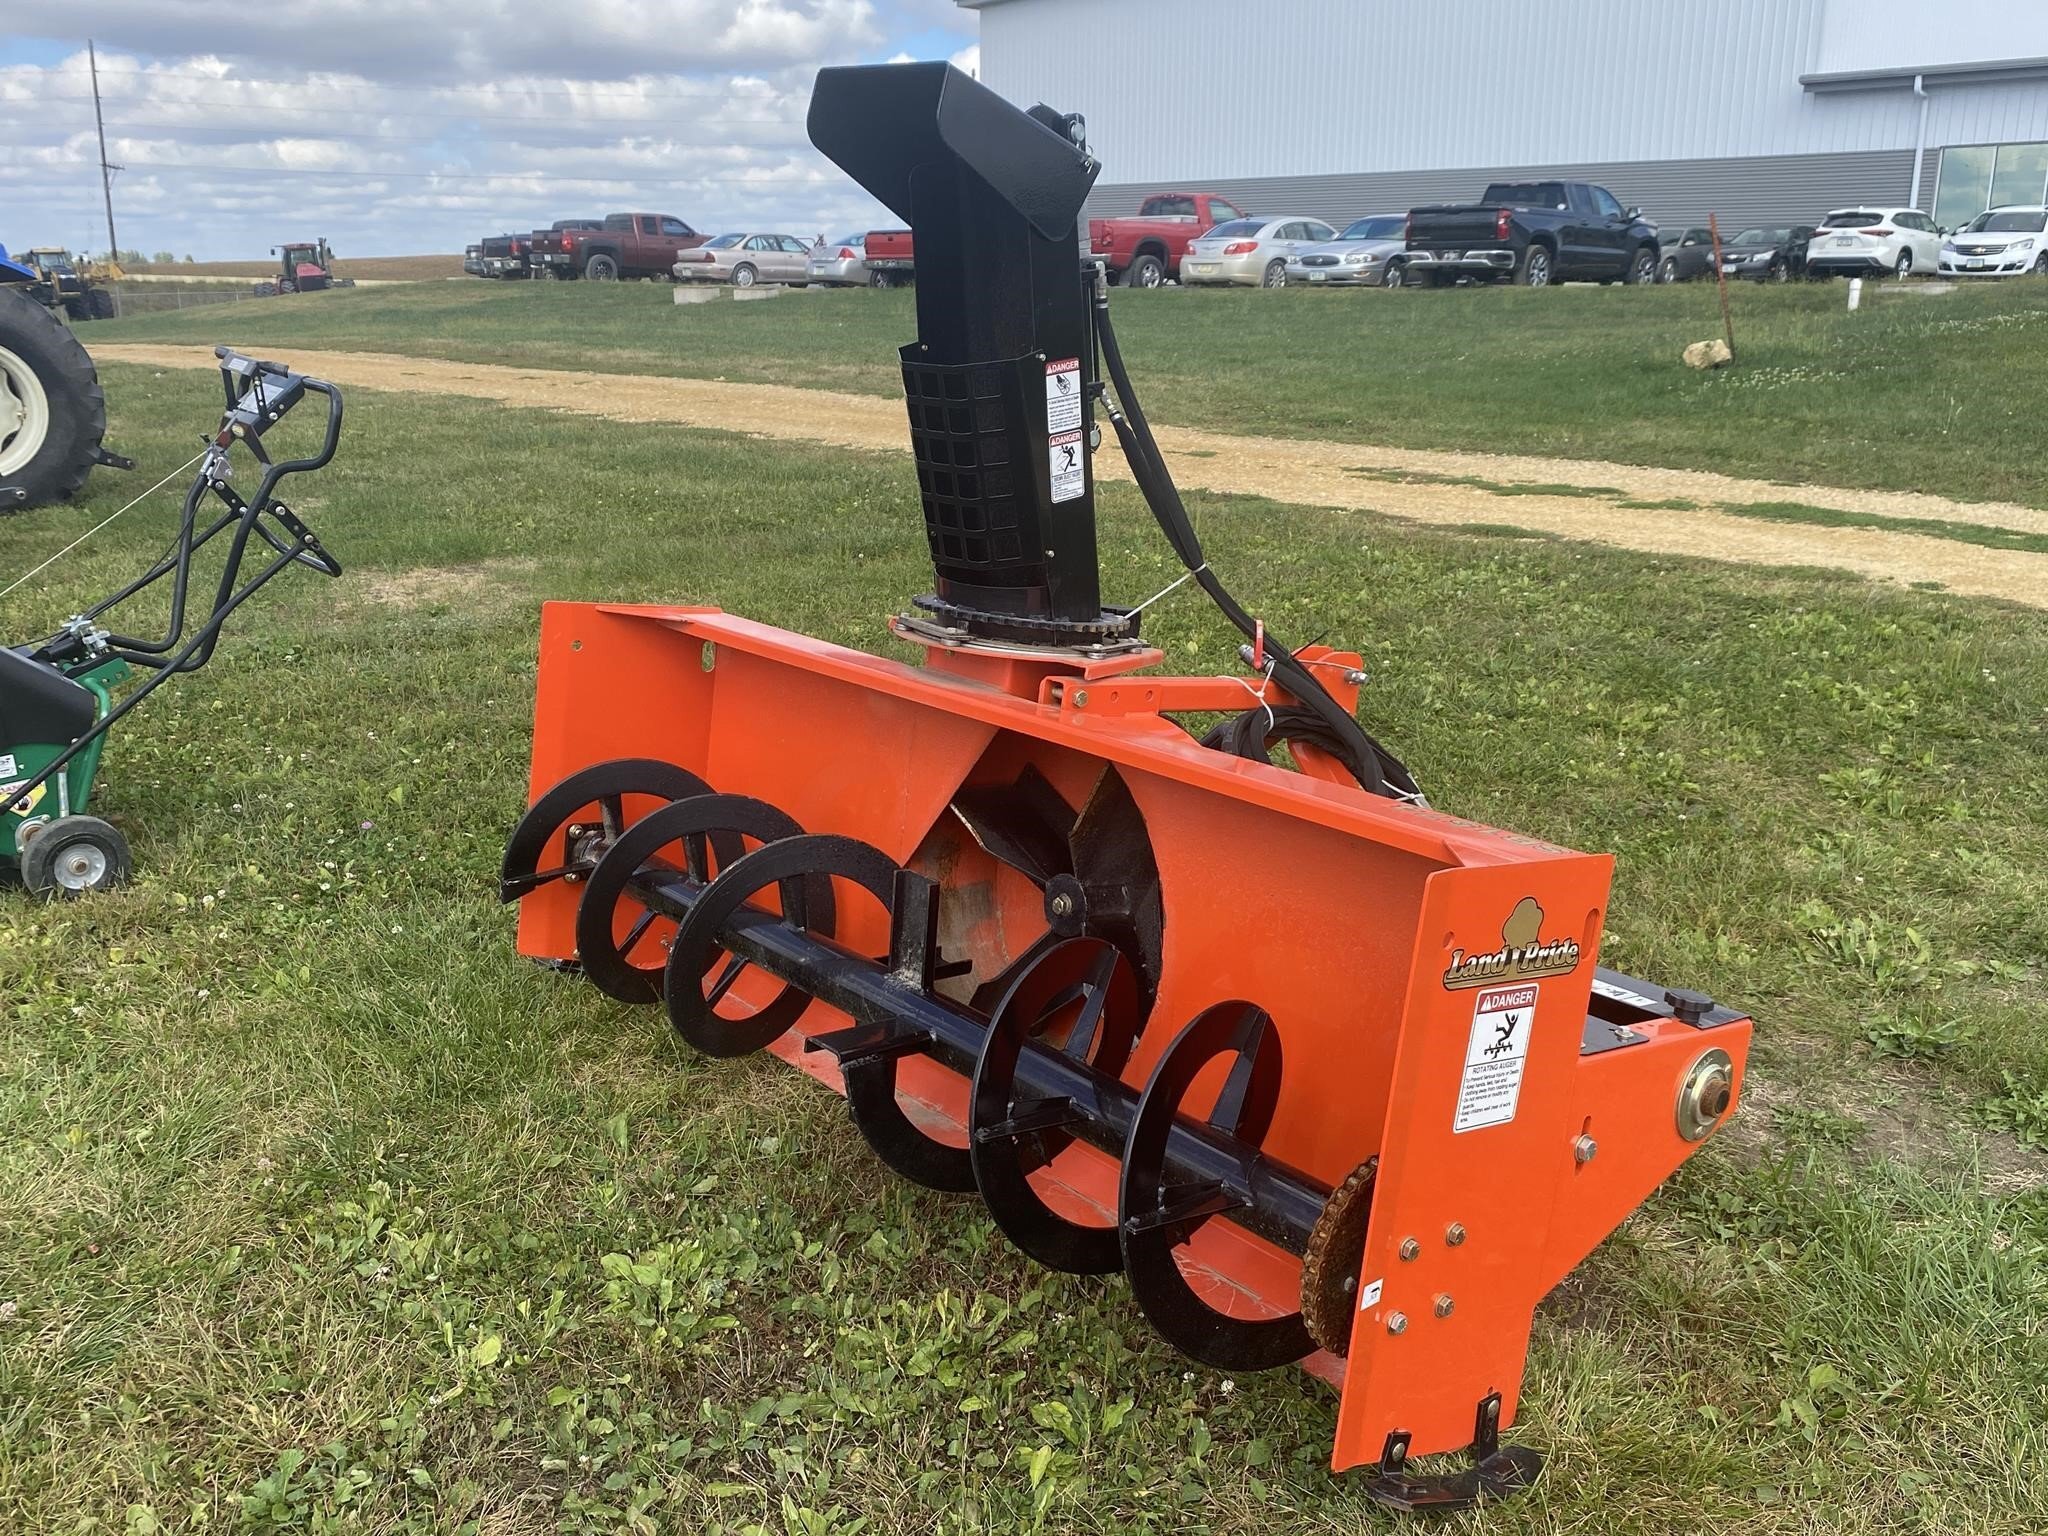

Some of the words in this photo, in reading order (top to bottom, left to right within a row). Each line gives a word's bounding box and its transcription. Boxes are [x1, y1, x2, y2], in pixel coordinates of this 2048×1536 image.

[1052, 360, 1079, 373] DANGER
[1055, 432, 1080, 445] DANGER
[1446, 944, 1510, 979] Land
[1519, 938, 1578, 970] Pride
[1492, 990, 1534, 1009] DANGER
[1472, 1064, 1498, 1075] ROTATING
[1499, 1060, 1517, 1070] AUGER
